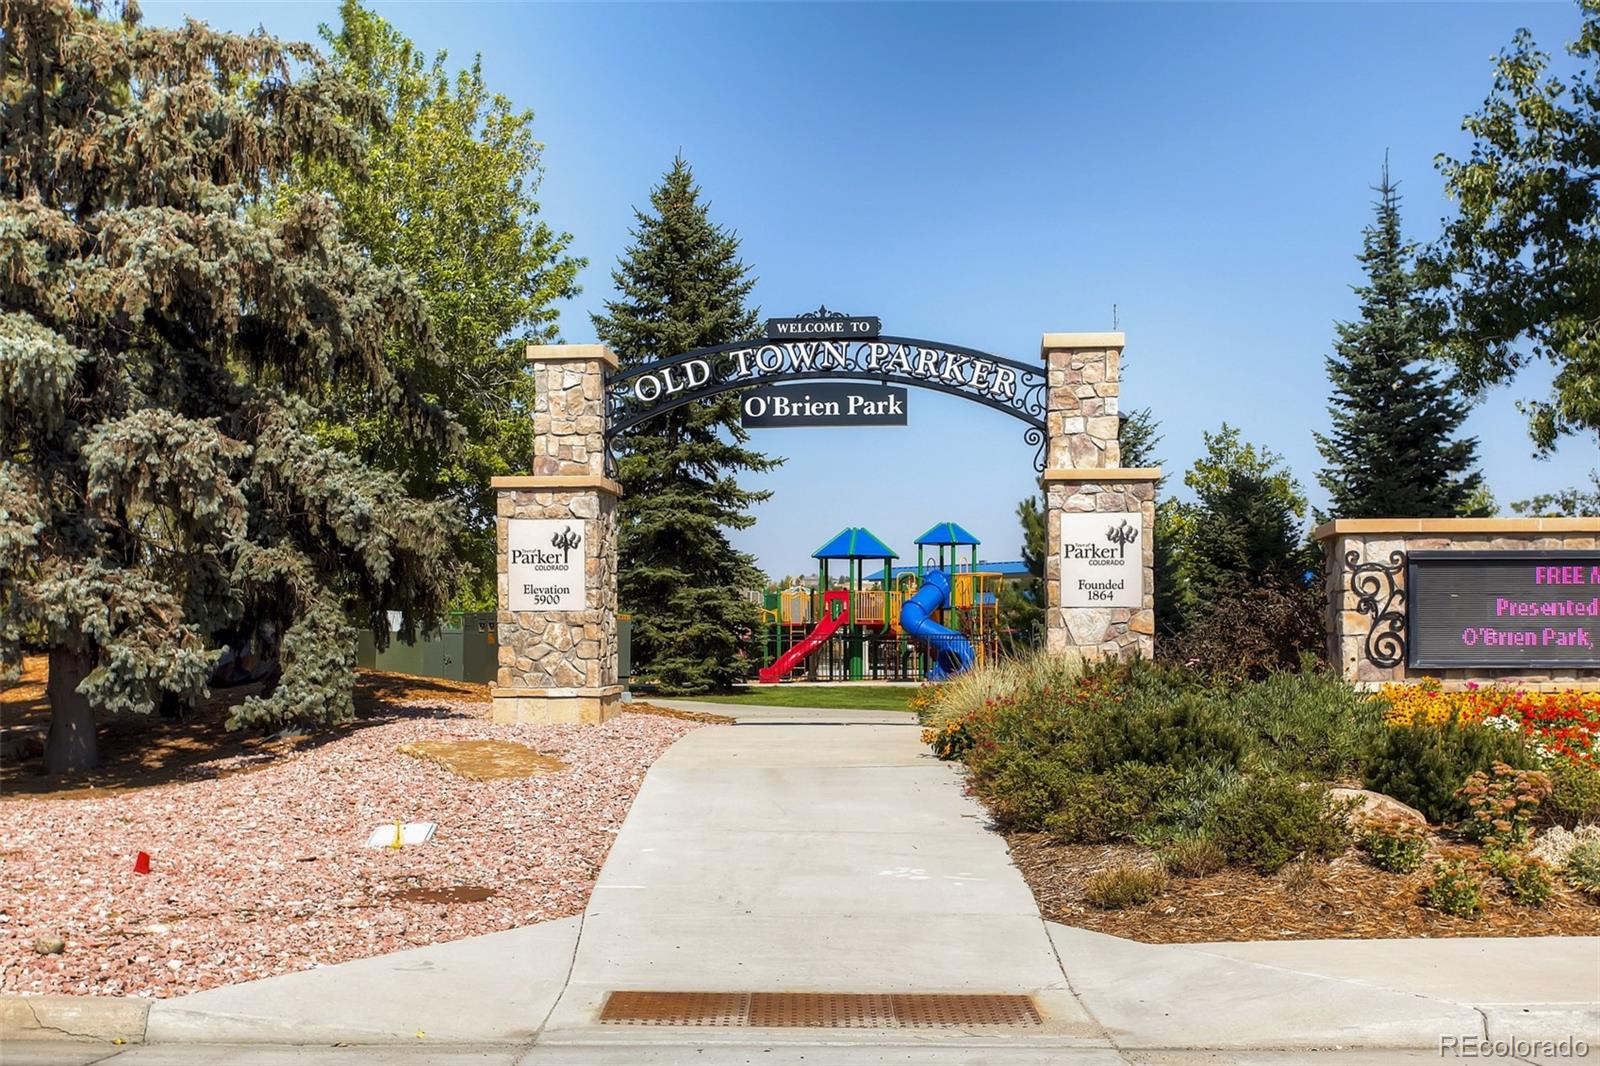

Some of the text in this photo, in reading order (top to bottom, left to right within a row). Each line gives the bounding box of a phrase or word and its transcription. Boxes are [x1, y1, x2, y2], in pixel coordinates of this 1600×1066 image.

[777, 321, 870, 333] WELCOME TO
[634, 341, 1016, 402] OLD TOWN PARKER
[744, 394, 904, 417] O'Brien Park
[512, 549, 562, 564] Parker
[1064, 544, 1118, 559] Parker
[1535, 566, 1585, 584] FREE
[523, 584, 570, 595] Elevation
[1078, 579, 1124, 590] Founded
[534, 594, 560, 605] 5900
[1088, 591, 1114, 601] 1864
[1496, 598, 1599, 616] Presented
[1462, 627, 1594, 650] O'Brien Park,
